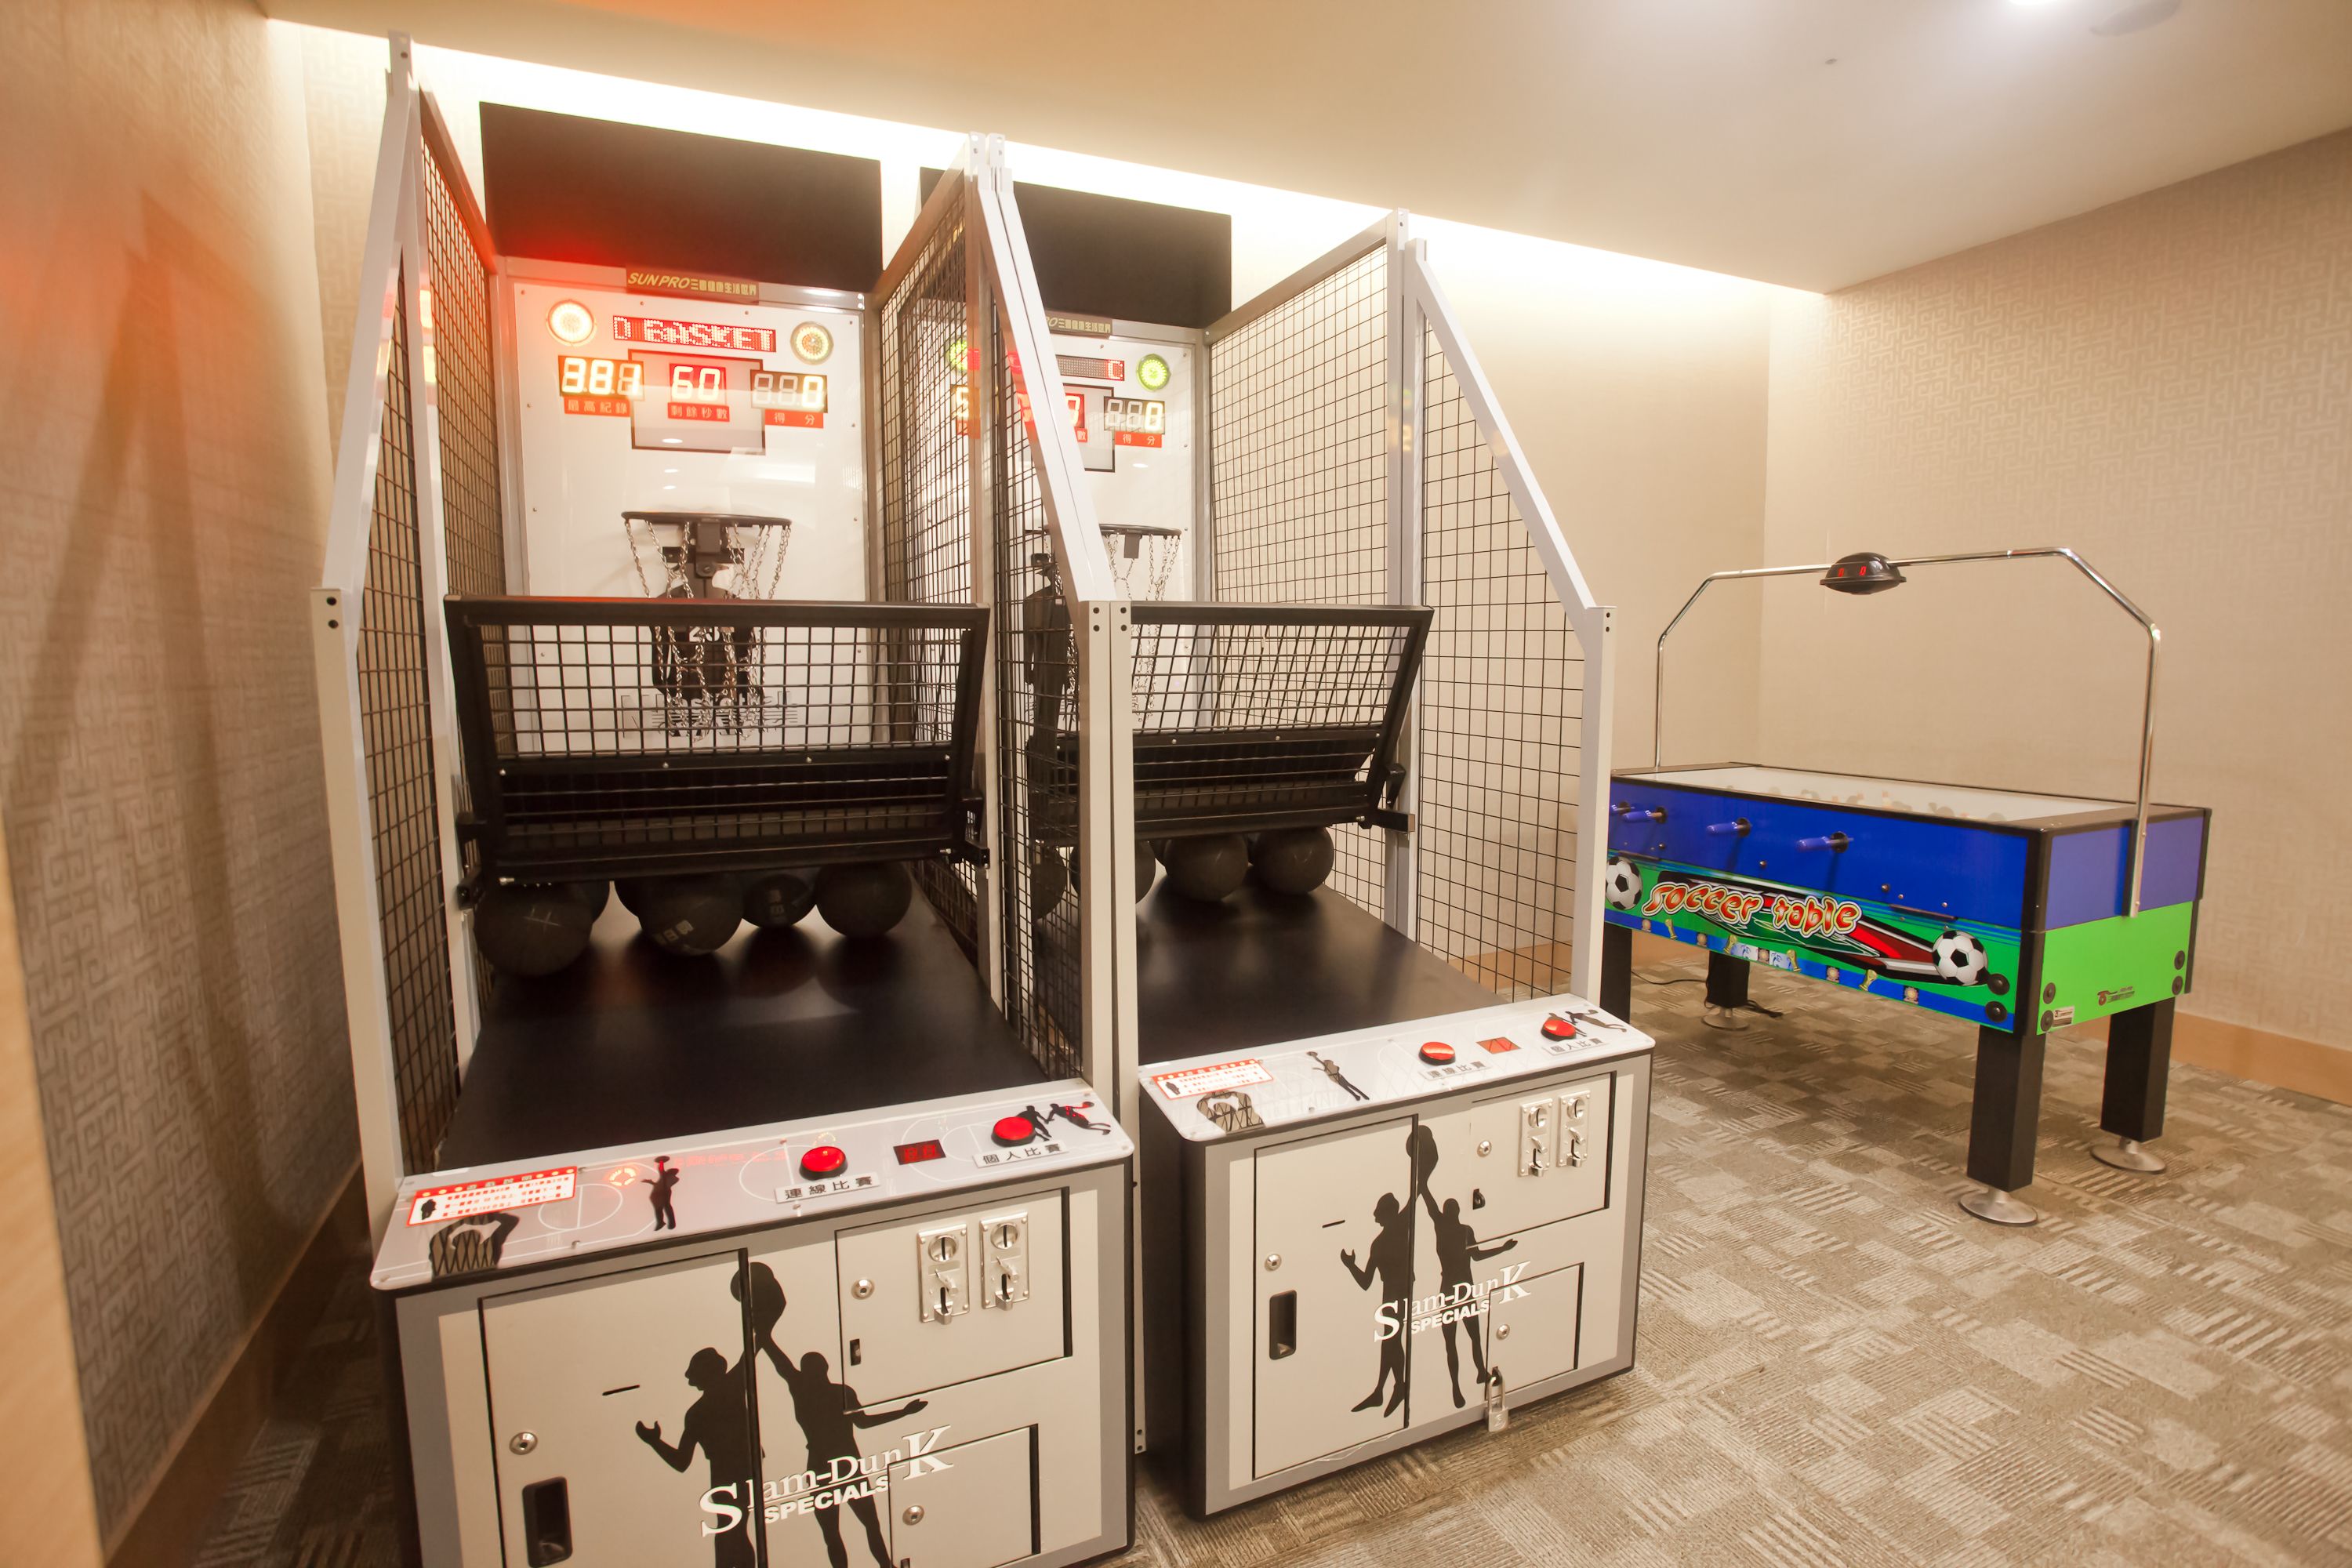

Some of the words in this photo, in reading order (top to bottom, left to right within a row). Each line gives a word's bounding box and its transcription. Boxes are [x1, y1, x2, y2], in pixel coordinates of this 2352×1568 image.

[644, 318, 774, 351] BASKET
[671, 365, 720, 401] 60
[774, 412, 815, 425] 得分
[1122, 433, 1156, 445] 得分
[1772, 895, 1861, 937] table
[982, 1144, 1062, 1165] 個人比賽
[785, 1175, 872, 1200] 連線比賽
[1411, 1299, 1490, 1334] SPECIALS
[764, 1475, 891, 1524] SPECIALS
